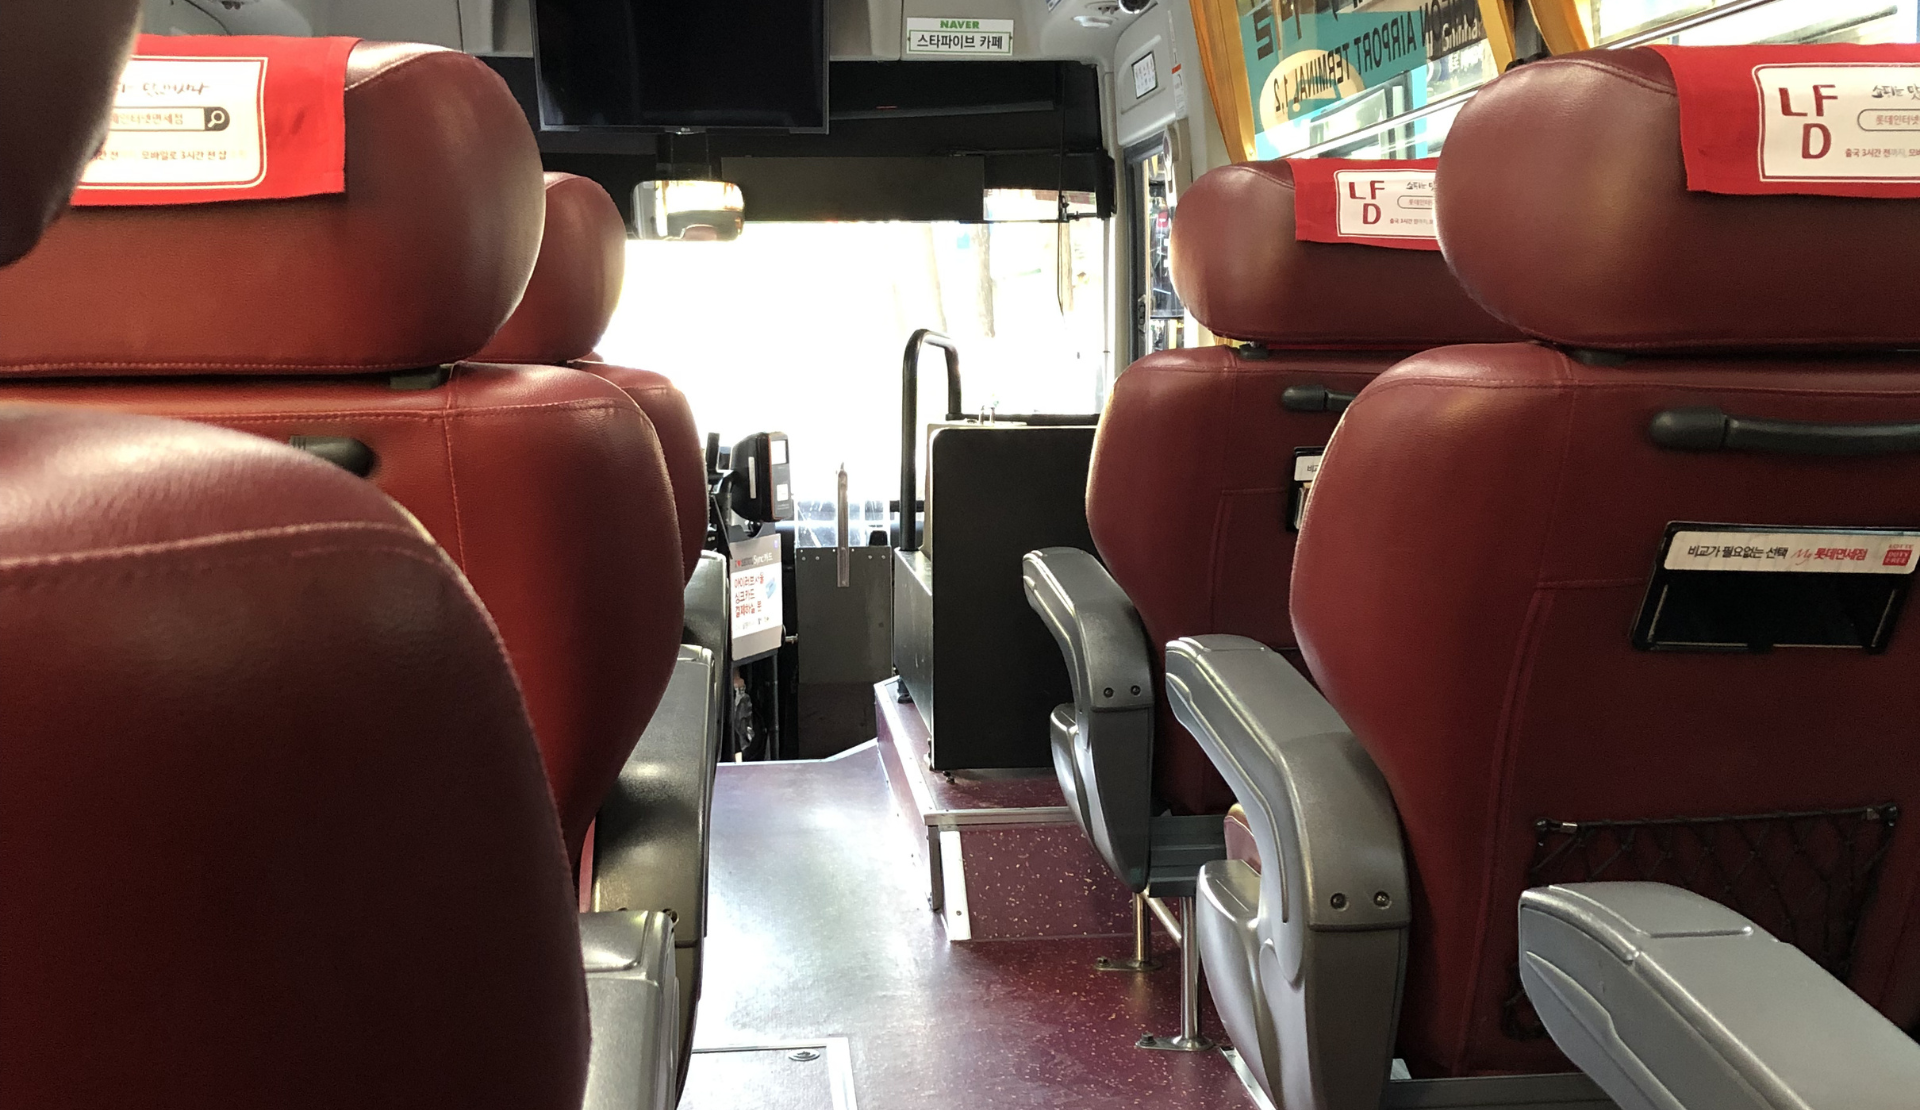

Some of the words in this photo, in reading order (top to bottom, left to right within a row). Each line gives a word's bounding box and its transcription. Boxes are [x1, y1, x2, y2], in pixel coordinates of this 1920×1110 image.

[940, 20, 980, 29] NAVER
[917, 34, 976, 49] 스타파이브
[979, 35, 1003, 49] 카페
[181, 150, 204, 160] 3시간
[1687, 545, 1720, 558] 비교가
[1722, 545, 1764, 559] 필요없는
[1766, 546, 1789, 559] 선택
[1814, 547, 1868, 561] 롯데면세점
